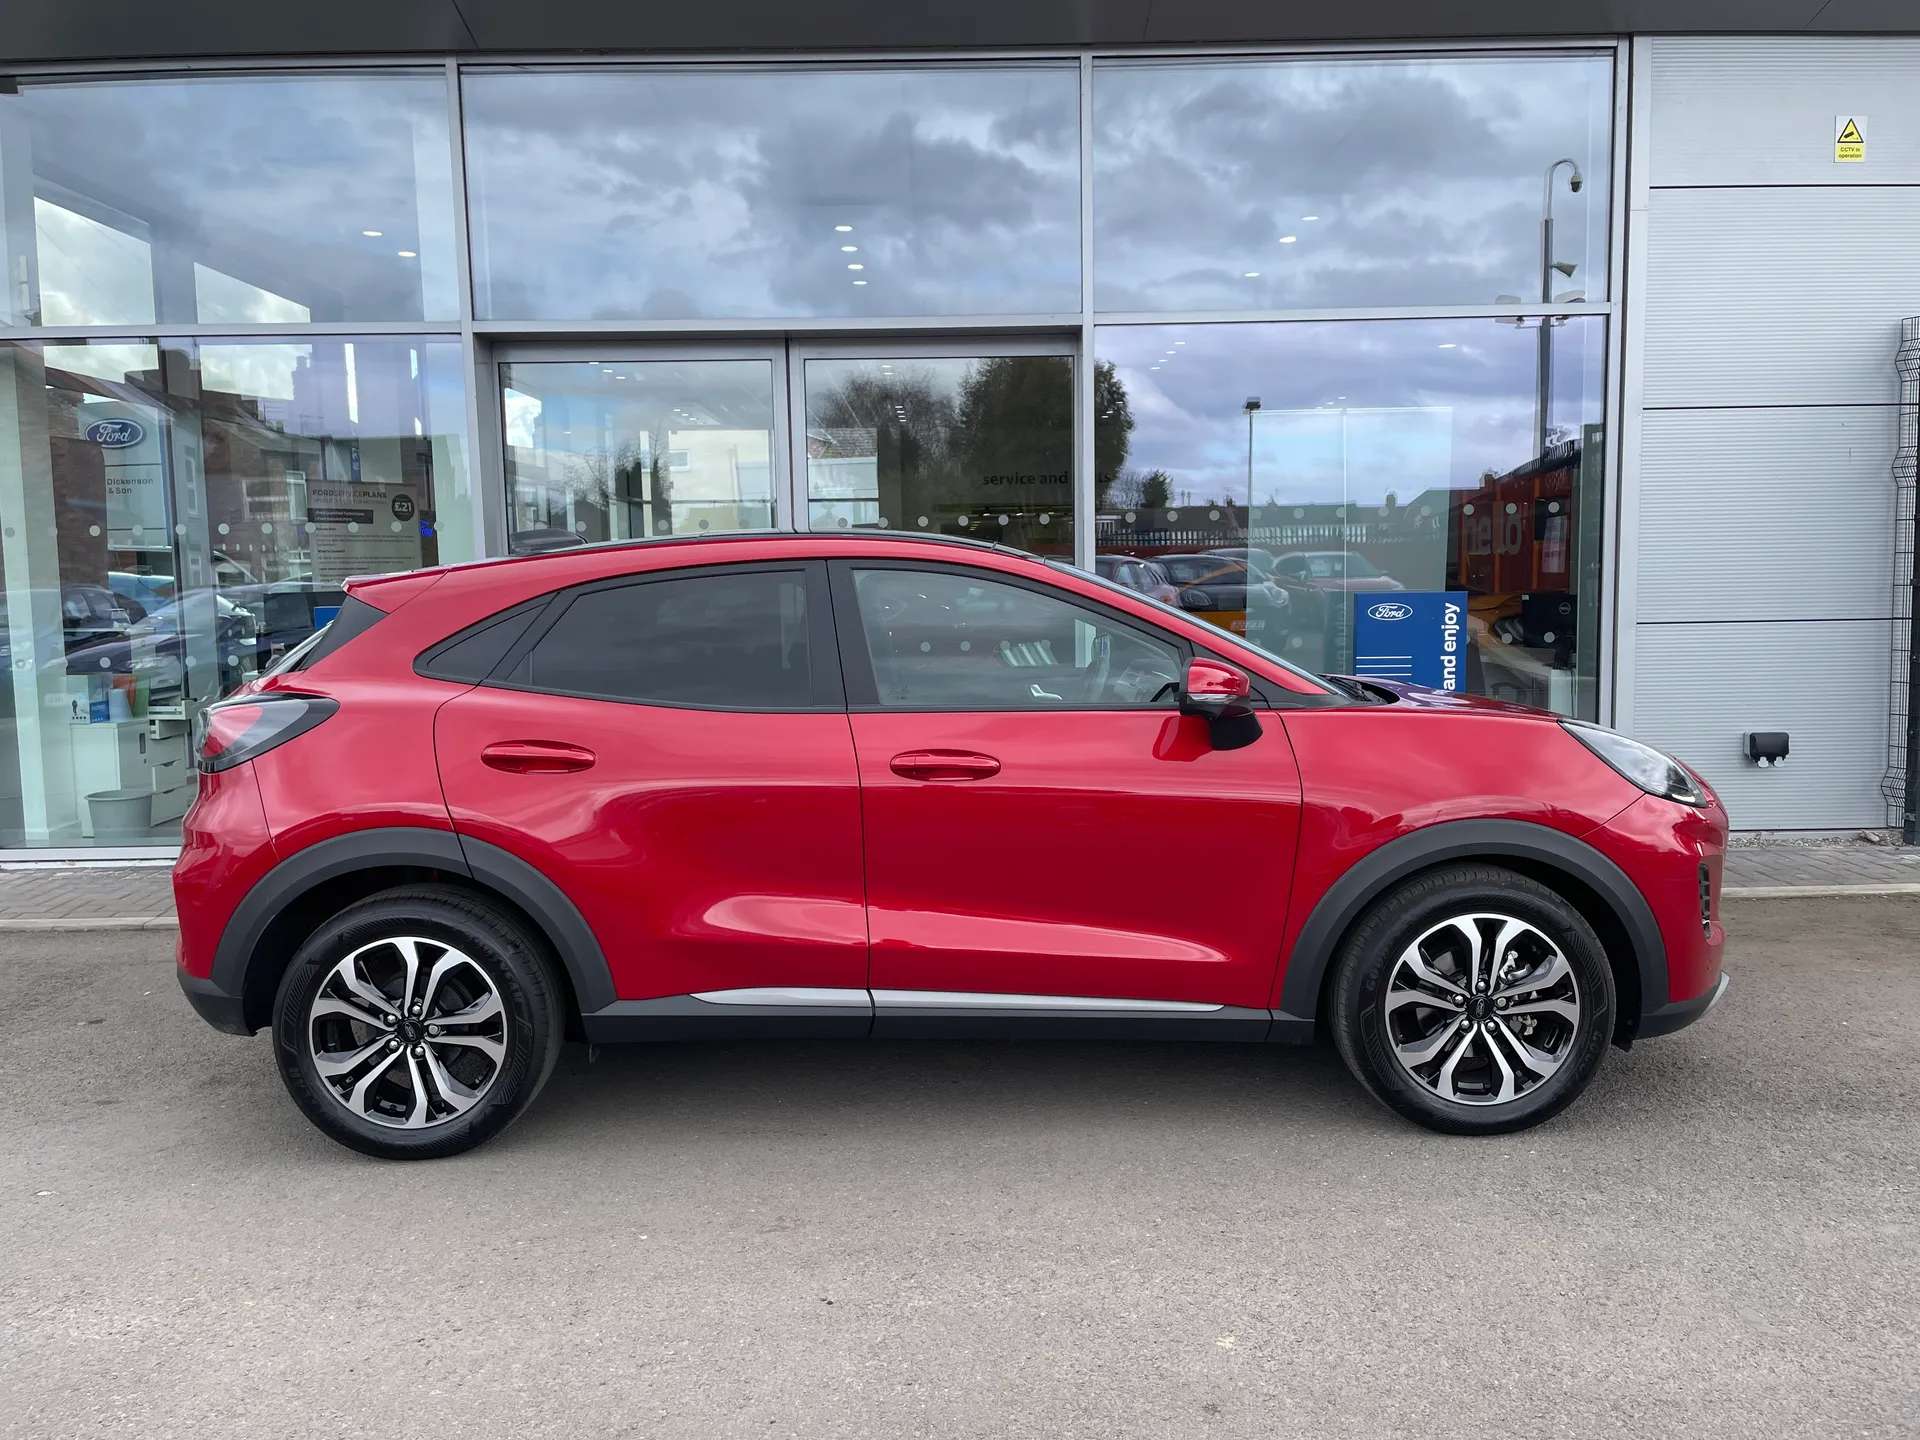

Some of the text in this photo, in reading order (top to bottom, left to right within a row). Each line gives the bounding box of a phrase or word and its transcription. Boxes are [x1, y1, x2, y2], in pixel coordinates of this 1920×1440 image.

[97, 423, 131, 442] Ford
[983, 471, 1068, 486] service and
[115, 487, 132, 495] Son
[1374, 604, 1405, 618] Ford
[1440, 602, 1460, 691] and enjoy
